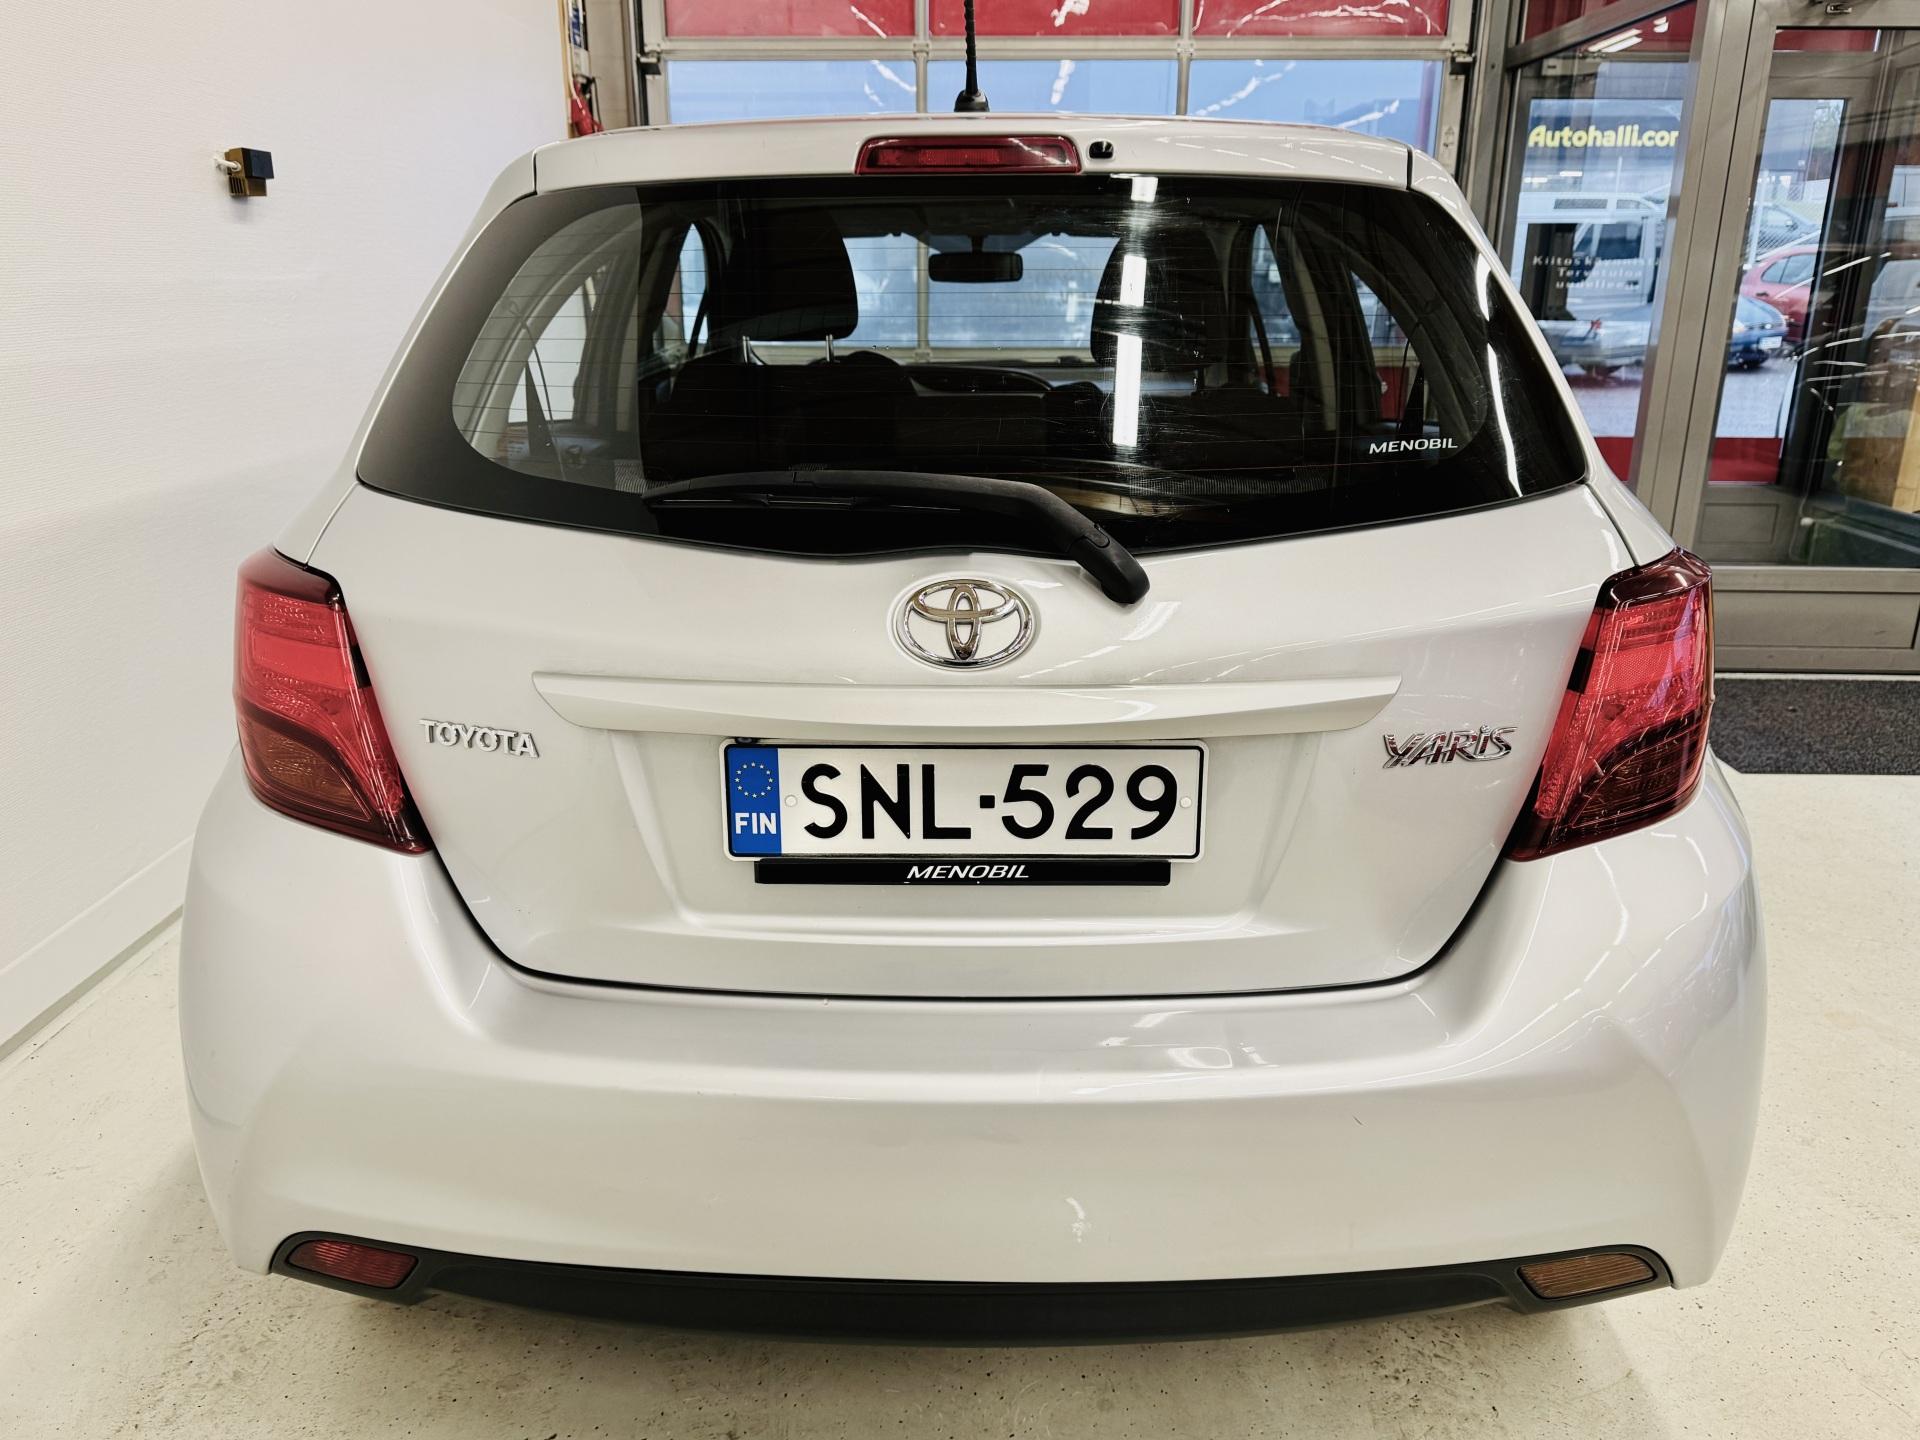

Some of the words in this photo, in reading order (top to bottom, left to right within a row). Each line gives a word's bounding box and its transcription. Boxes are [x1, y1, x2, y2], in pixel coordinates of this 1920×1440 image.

[1368, 437, 1459, 455] MENOBIL
[419, 718, 540, 758] TOYOTA
[735, 812, 777, 835] FIN
[906, 864, 1030, 879] MENOBIL
